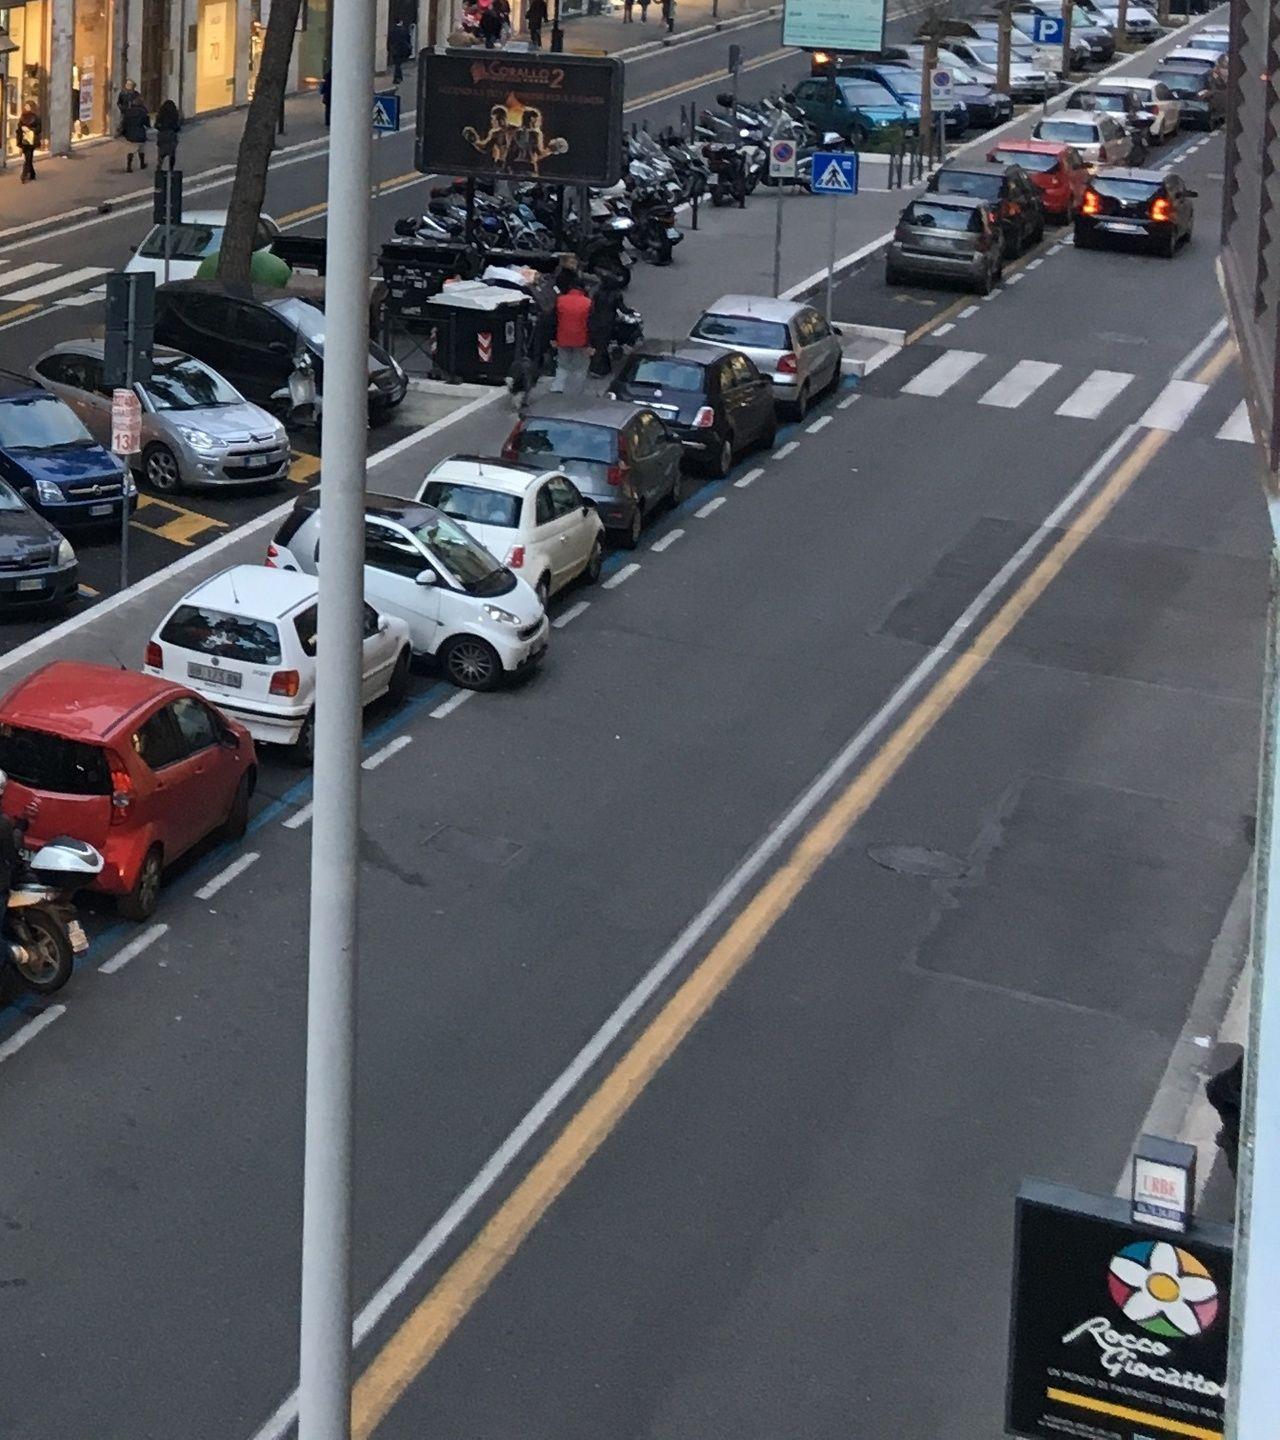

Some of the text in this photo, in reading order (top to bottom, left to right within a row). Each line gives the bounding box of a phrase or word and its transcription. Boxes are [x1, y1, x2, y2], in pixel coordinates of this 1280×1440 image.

[1039, 20, 1059, 41] P
[549, 68, 565, 89] 2
[1061, 1316, 1171, 1357] Rocco
[1100, 1346, 1228, 1400] Giocatto
